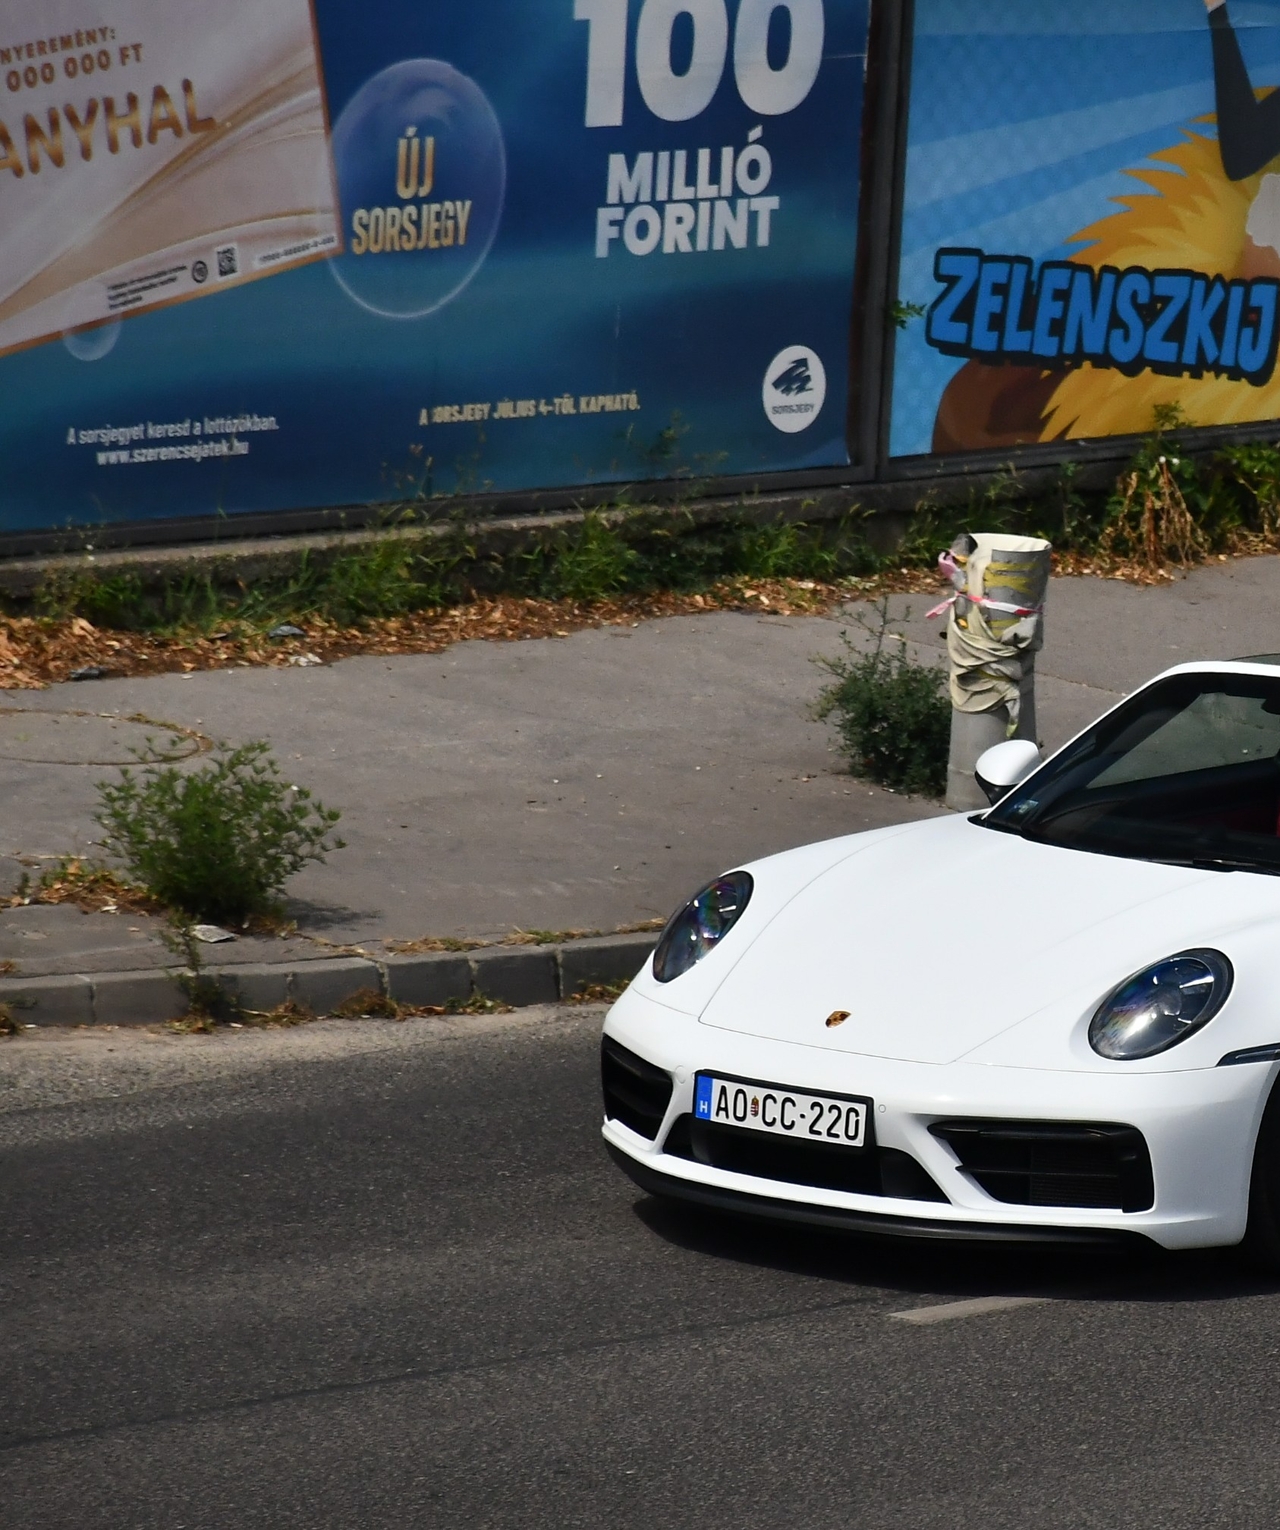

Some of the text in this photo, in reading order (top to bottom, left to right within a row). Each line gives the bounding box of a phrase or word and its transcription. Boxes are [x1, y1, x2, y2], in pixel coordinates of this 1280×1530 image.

[6, 43, 143, 92] 000 000 FT
[574, 0, 825, 128] 100
[395, 125, 435, 199] ÚJ
[606, 125, 772, 204] MILLIÓ
[351, 200, 472, 255] SORSJEGY
[595, 196, 780, 258] FORINT
[928, 250, 1280, 380] ZELENSZKIJ
[67, 427, 77, 445] A
[79, 421, 145, 446] sorsjegyet
[147, 417, 191, 439] keresd
[193, 421, 202, 435] a
[419, 408, 429, 426] A
[493, 397, 536, 419] JÚLIUS
[771, 403, 815, 415] SORSJEGY
[699, 1100, 708, 1114] H
